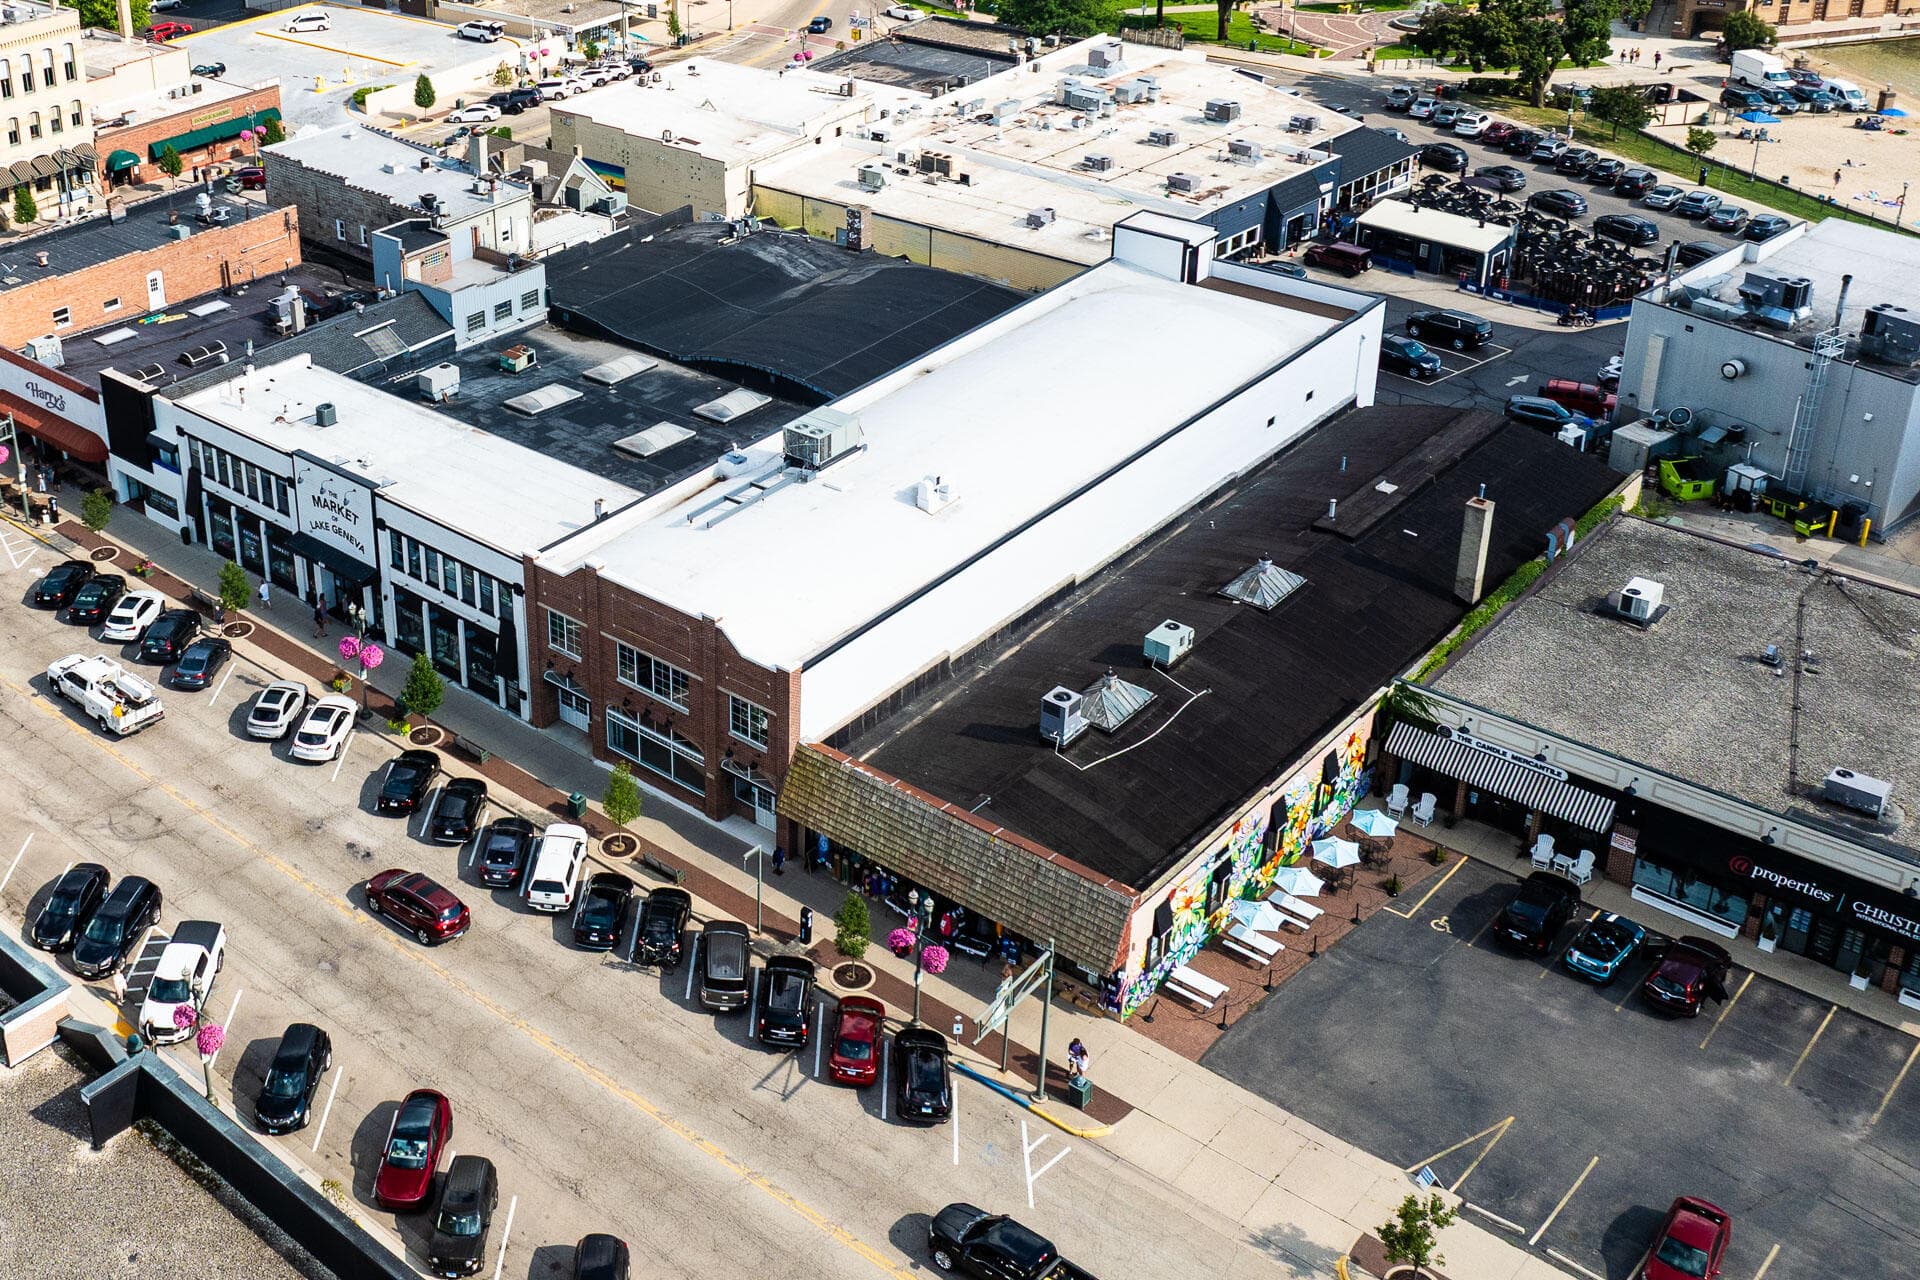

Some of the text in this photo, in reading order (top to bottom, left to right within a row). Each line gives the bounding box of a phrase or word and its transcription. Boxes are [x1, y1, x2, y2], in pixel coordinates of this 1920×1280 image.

[25, 381, 66, 412] Harry's
[311, 494, 360, 526] MARKET
[328, 489, 338, 499] THE
[309, 520, 365, 555] LAKE GENEVA
[1456, 733, 1563, 778] THE CANDLE MERCANTILE
